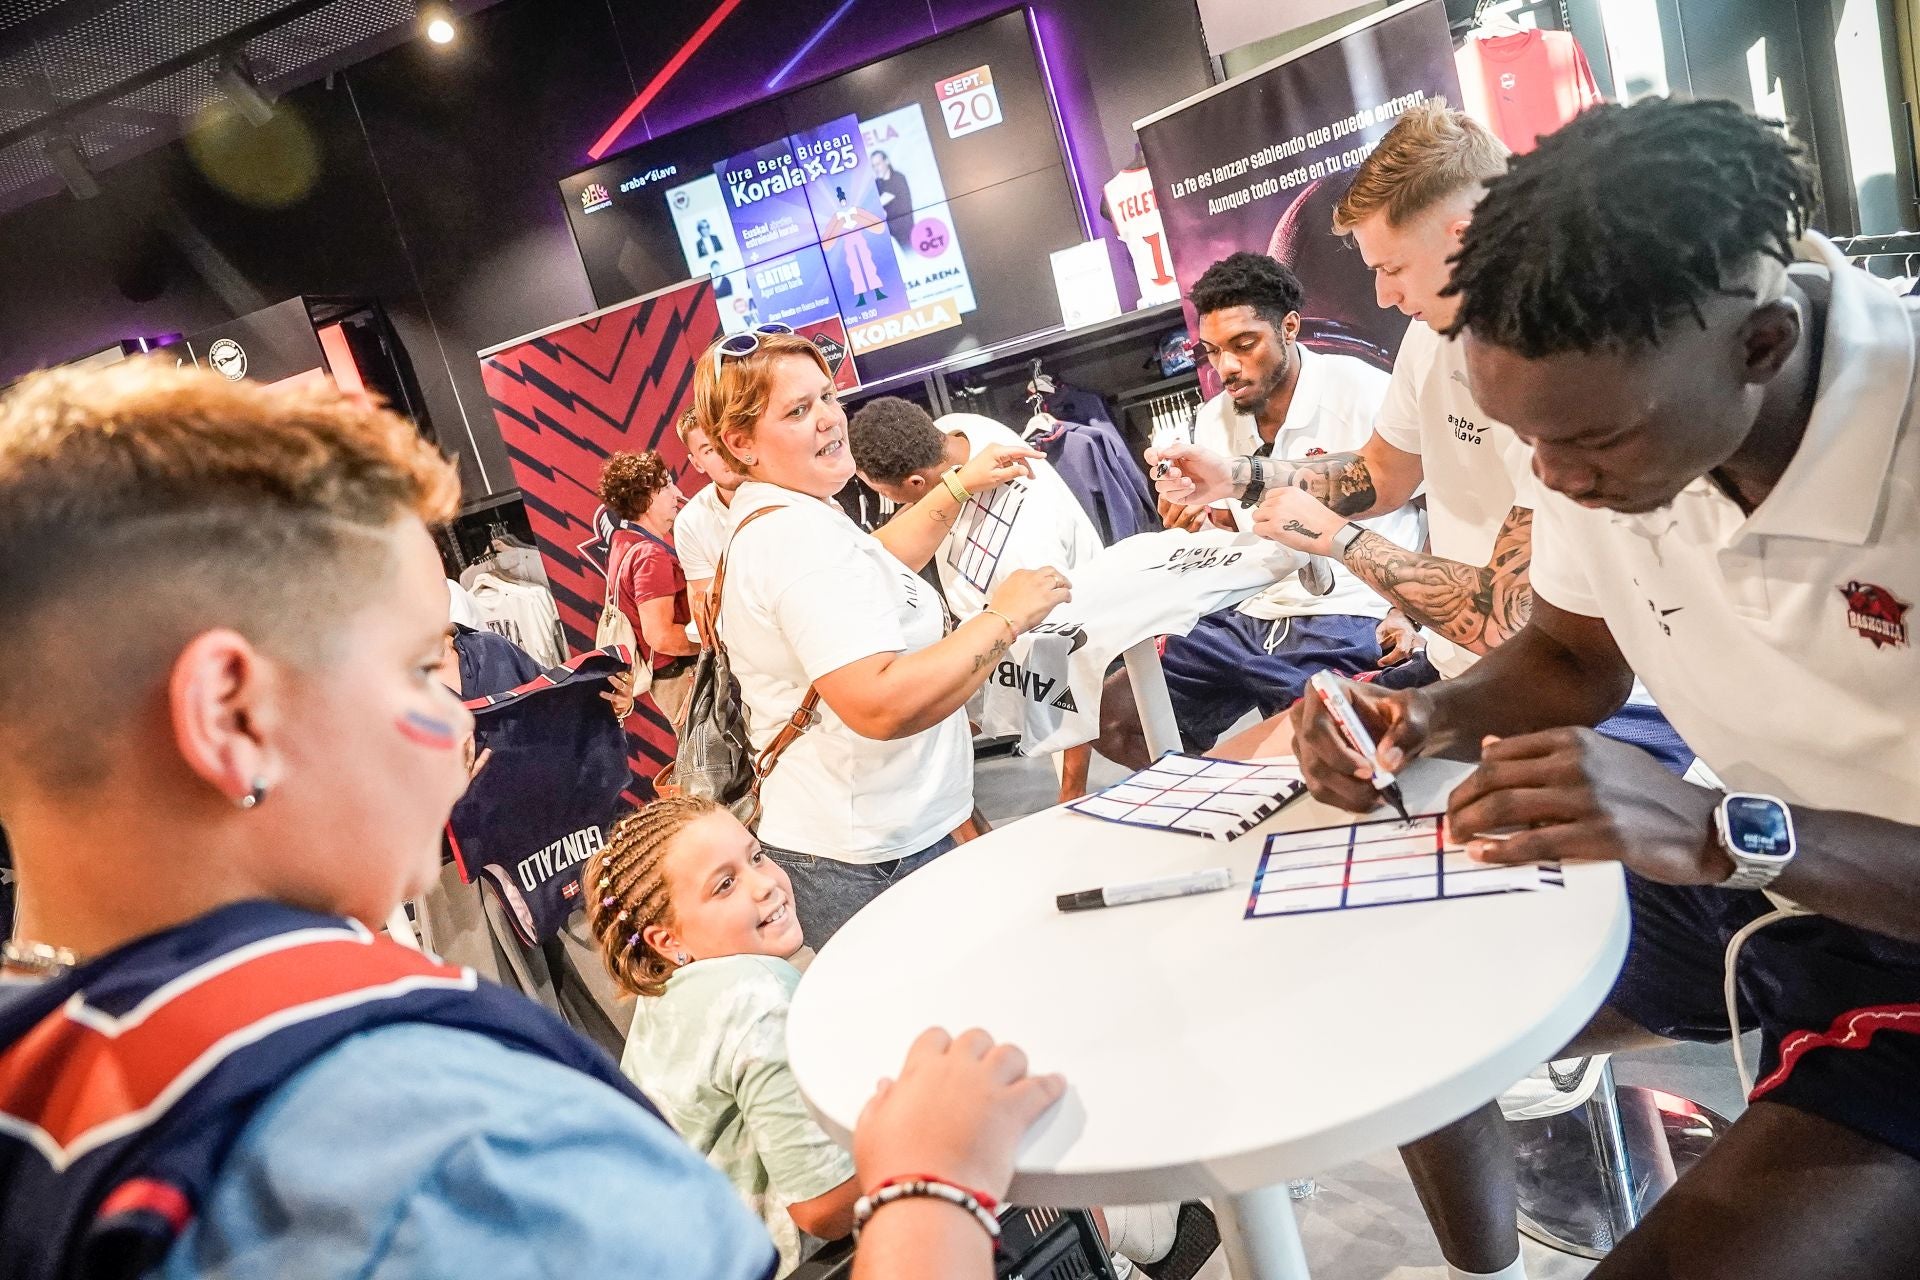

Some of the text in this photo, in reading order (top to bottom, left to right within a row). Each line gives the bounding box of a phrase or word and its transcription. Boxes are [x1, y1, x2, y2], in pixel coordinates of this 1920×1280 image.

[943, 73, 984, 96] SEPT.
[948, 92, 994, 130] 20
[727, 133, 851, 185] Ura Bere Bidean
[1171, 182, 1185, 199] La
[1184, 177, 1198, 194] fe
[1197, 172, 1213, 189] es
[1211, 157, 1250, 184] lanzar
[1250, 136, 1306, 169] sabiendo
[1306, 126, 1331, 149] que
[1332, 109, 1375, 140] puede
[730, 144, 858, 208] Korala 25
[1208, 188, 1251, 216] Aunque
[1250, 178, 1279, 200] todo
[1308, 161, 1326, 182] en
[1325, 155, 1342, 174] tu
[1342, 140, 1381, 168] cont
[742, 222, 769, 240] Euskal
[919, 236, 945, 251] OCT
[925, 227, 933, 237] 3
[905, 267, 960, 290] SA ARENA
[1142, 232, 1174, 286] 1
[853, 305, 951, 349] KORALA
[989, 660, 1056, 702] AMB
[1057, 700, 1075, 710] 1900
[517, 825, 605, 892] GONZALO
